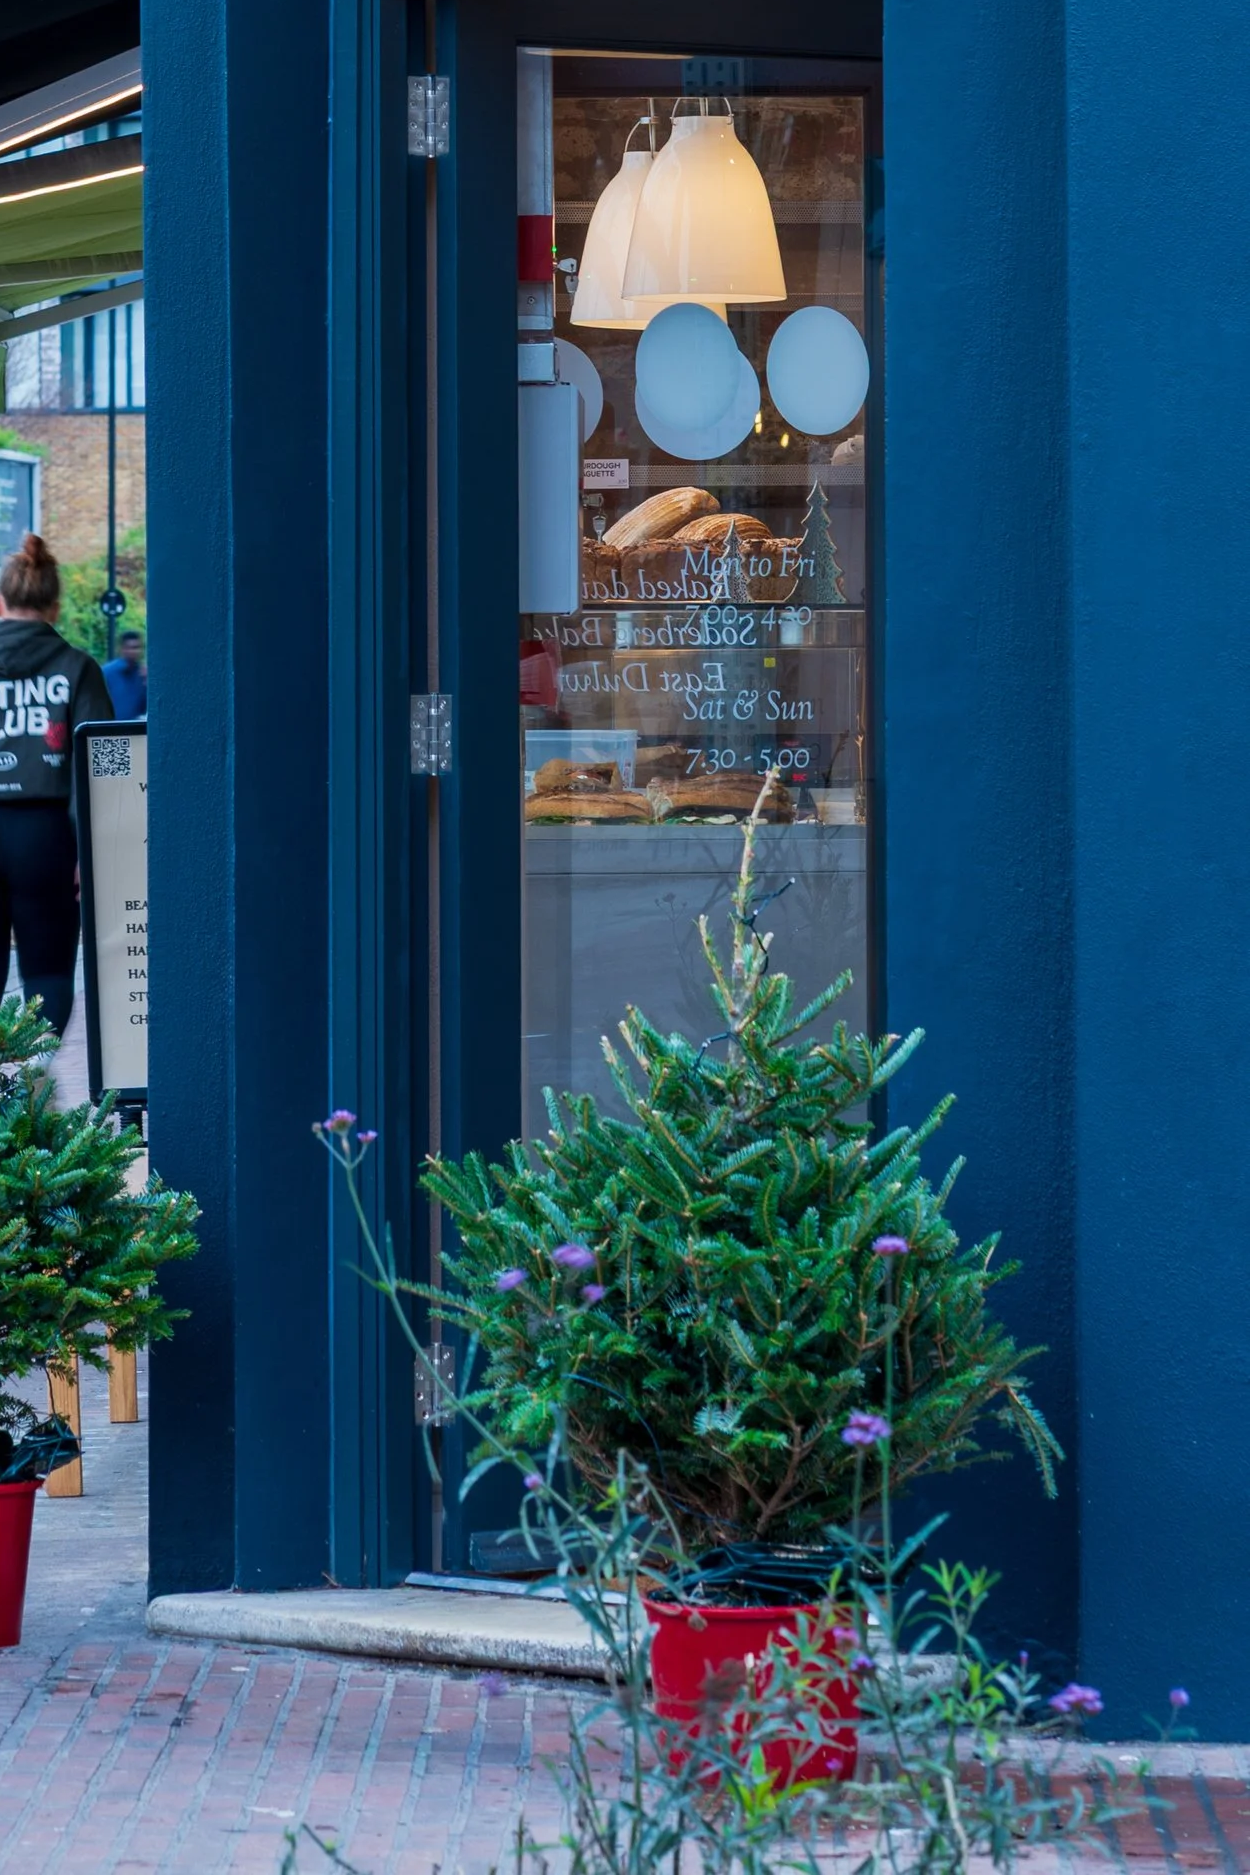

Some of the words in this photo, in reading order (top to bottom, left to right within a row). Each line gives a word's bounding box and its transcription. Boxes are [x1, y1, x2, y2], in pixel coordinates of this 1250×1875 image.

[683, 545, 742, 576] Mon
[749, 554, 772, 577] to
[779, 546, 816, 578] Fri
[683, 689, 725, 721] Sat
[732, 689, 759, 721] &
[765, 689, 814, 721] Sun
[685, 748, 736, 775] 7.30
